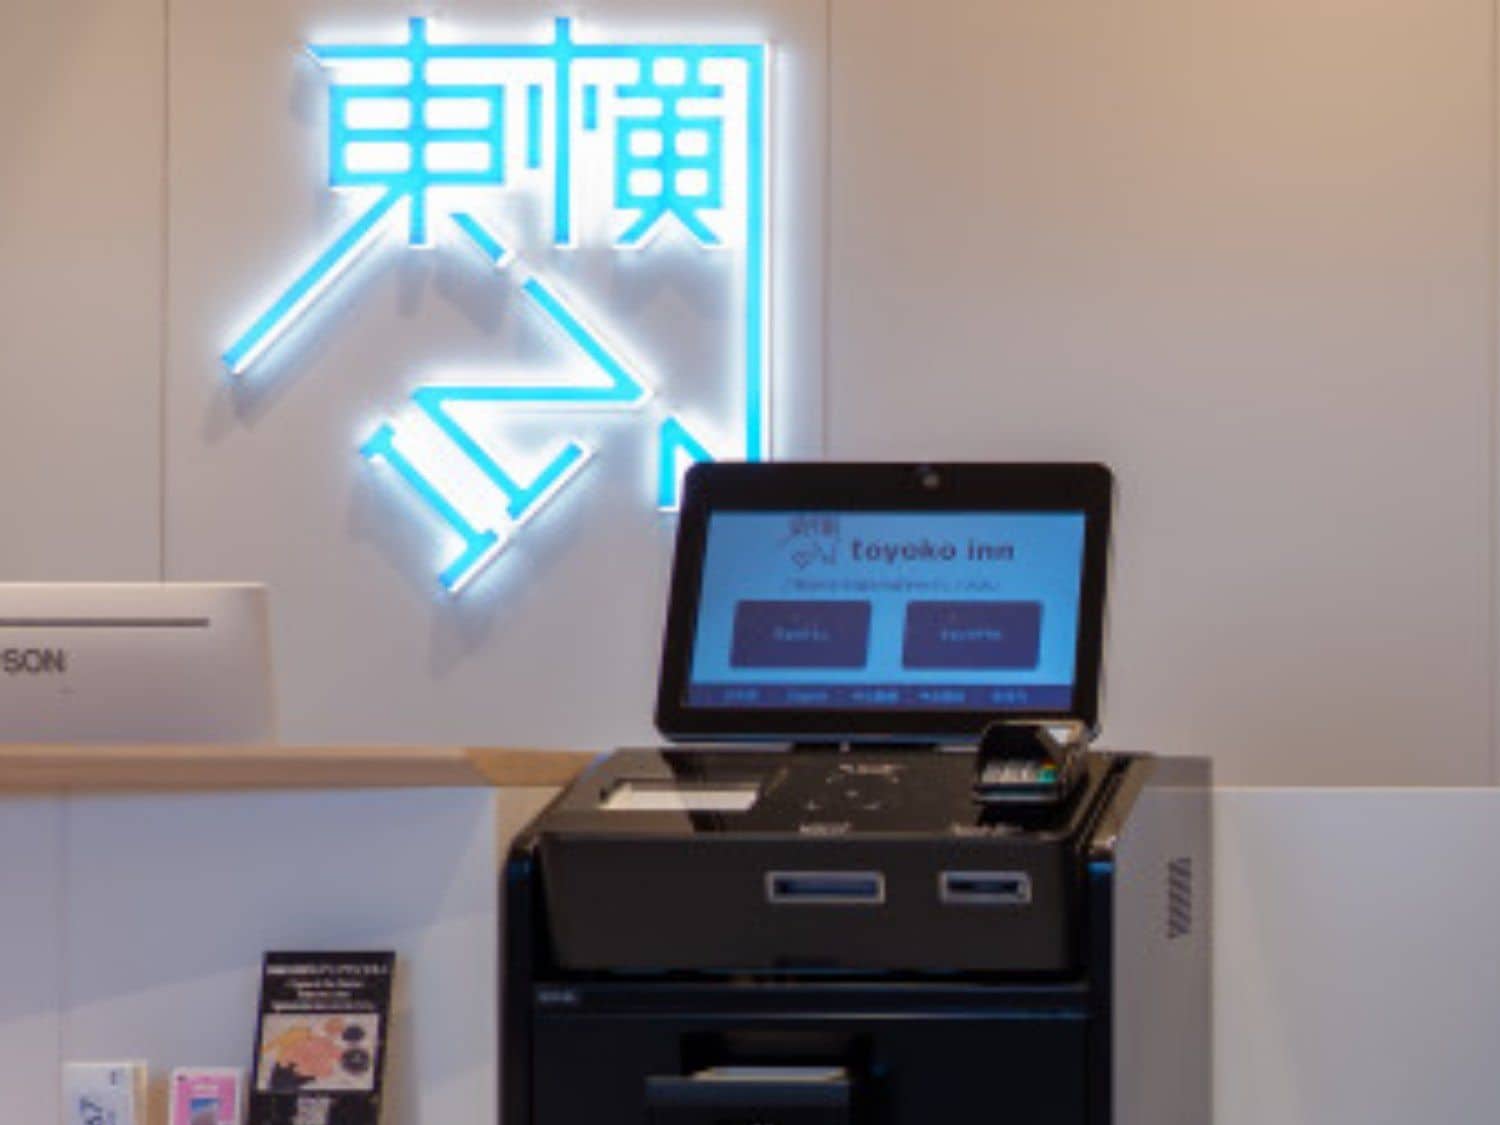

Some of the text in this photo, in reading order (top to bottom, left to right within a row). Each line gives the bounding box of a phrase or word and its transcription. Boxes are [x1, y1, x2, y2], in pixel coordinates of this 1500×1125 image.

[851, 536, 956, 566] toyoko
[966, 537, 1015, 562] inn
[0, 647, 66, 673] SON
